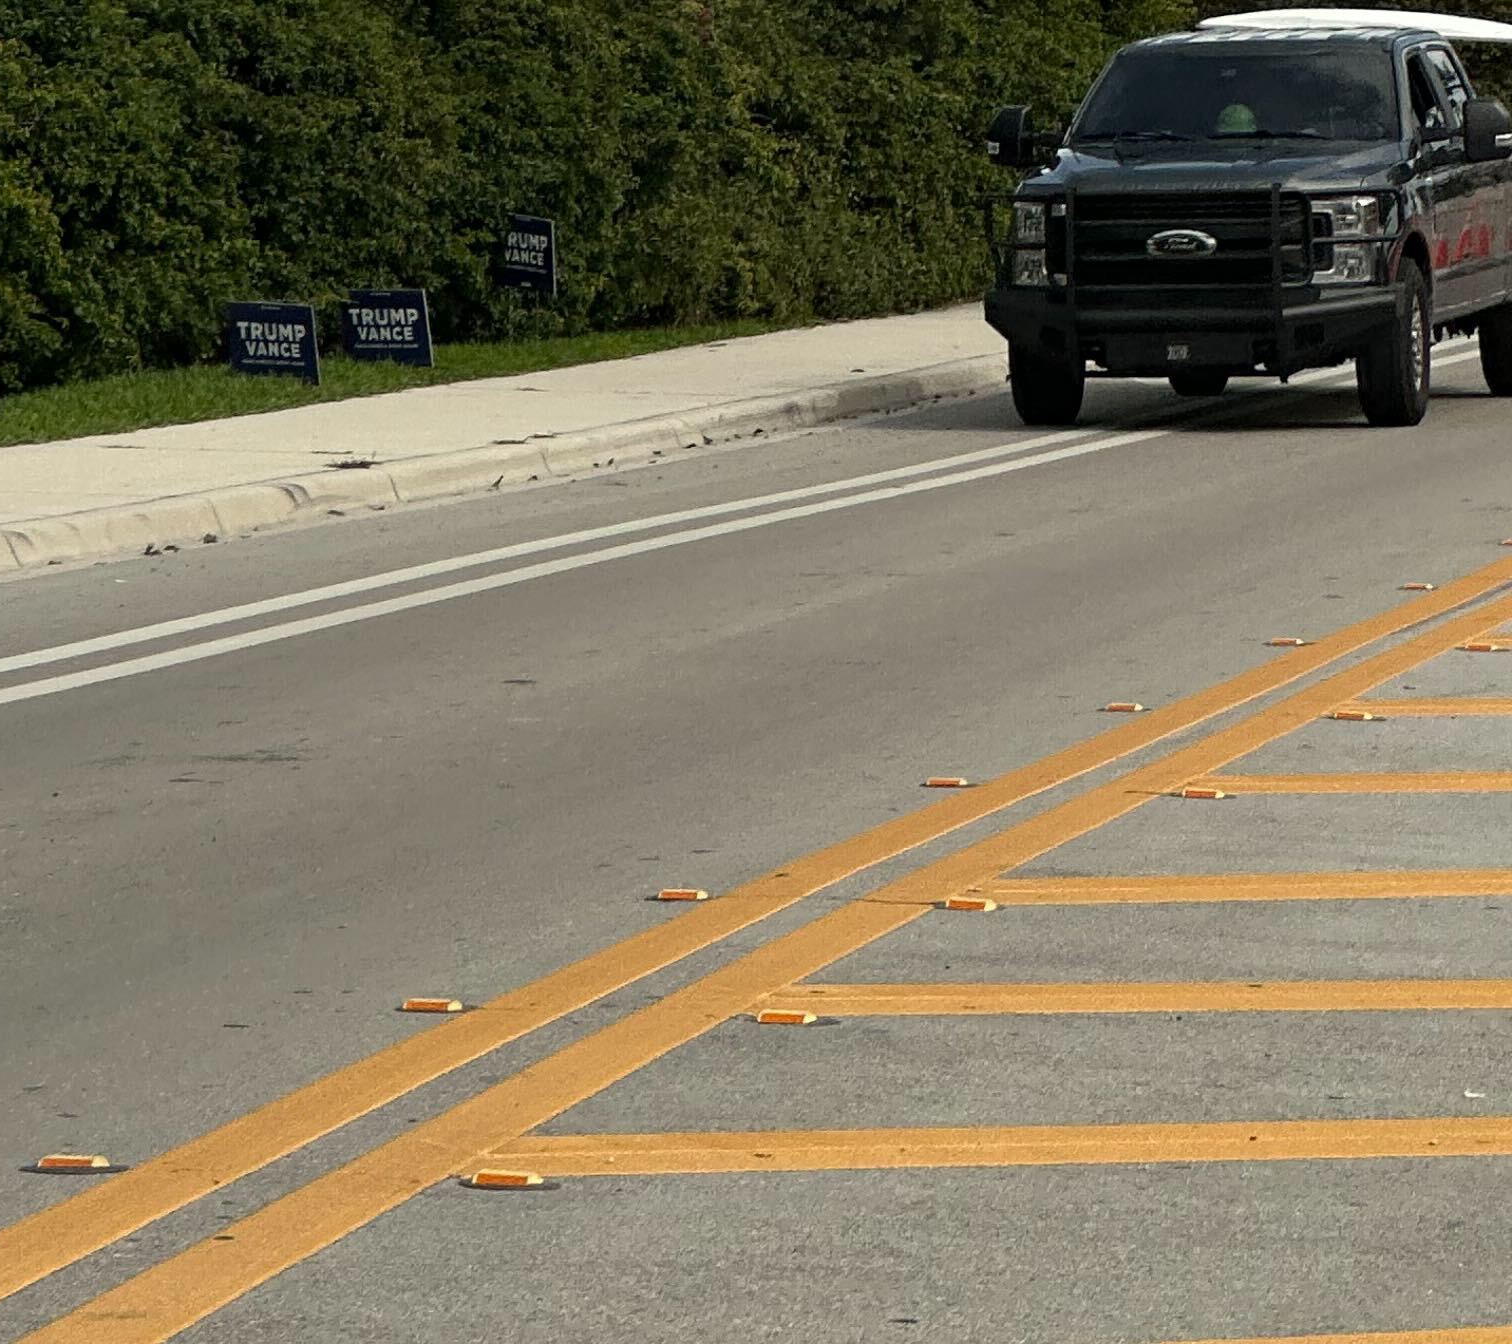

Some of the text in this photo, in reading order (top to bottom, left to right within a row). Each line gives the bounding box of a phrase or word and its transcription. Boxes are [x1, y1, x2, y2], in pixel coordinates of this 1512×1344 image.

[507, 231, 548, 252] RUMP
[504, 248, 545, 266] VANCE
[348, 308, 419, 326] TRUMP
[236, 321, 307, 342] TRUMP
[357, 326, 414, 341] VANCE
[245, 340, 301, 358] VANCE
